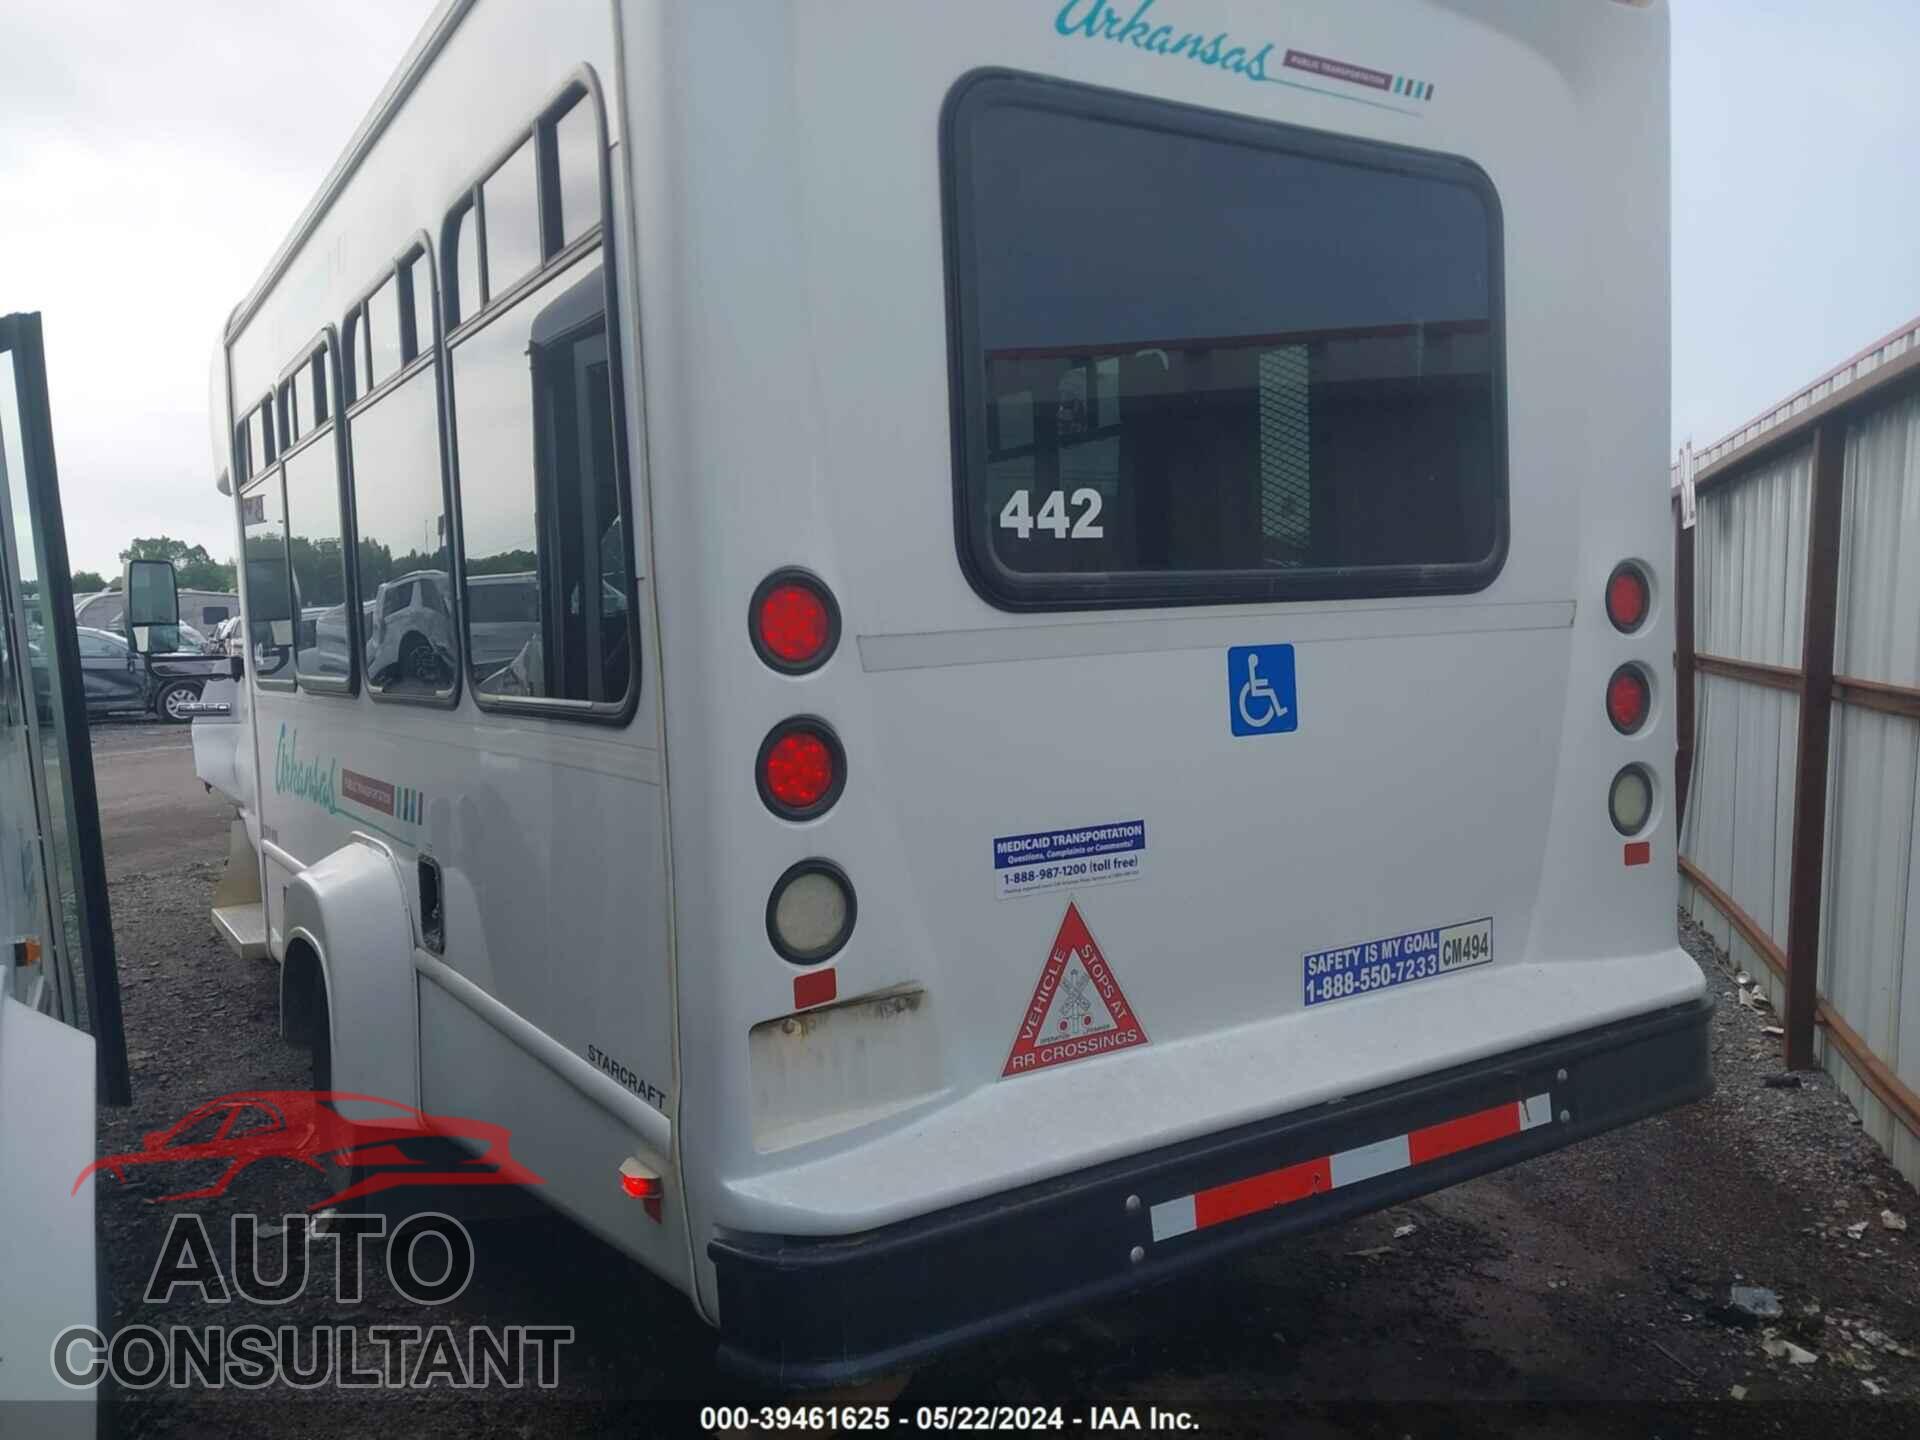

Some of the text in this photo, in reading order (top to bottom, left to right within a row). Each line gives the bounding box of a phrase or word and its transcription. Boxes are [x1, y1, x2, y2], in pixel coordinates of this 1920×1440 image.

[1055, 0, 1275, 81] Arkansas
[1000, 488, 1104, 539] 442
[997, 825, 1142, 853] MEDICAID TRANSPORTATION
[1003, 863, 1087, 885] 1-888-987-1200
[1089, 859, 1111, 873] (toll
[1113, 855, 1138, 869] free)
[1308, 931, 1438, 976] SAFETY IS MY GOAL
[1443, 932, 1489, 966] CM494
[1022, 949, 1066, 1039] VEHICLE
[1081, 944, 1115, 999] STOPS
[1111, 1001, 1127, 1019] AT
[1306, 954, 1438, 1003] 1-888-550-7233
[1012, 1029, 1137, 1069] RR CROSSINGS
[588, 1044, 667, 1109] STARCRAFT
